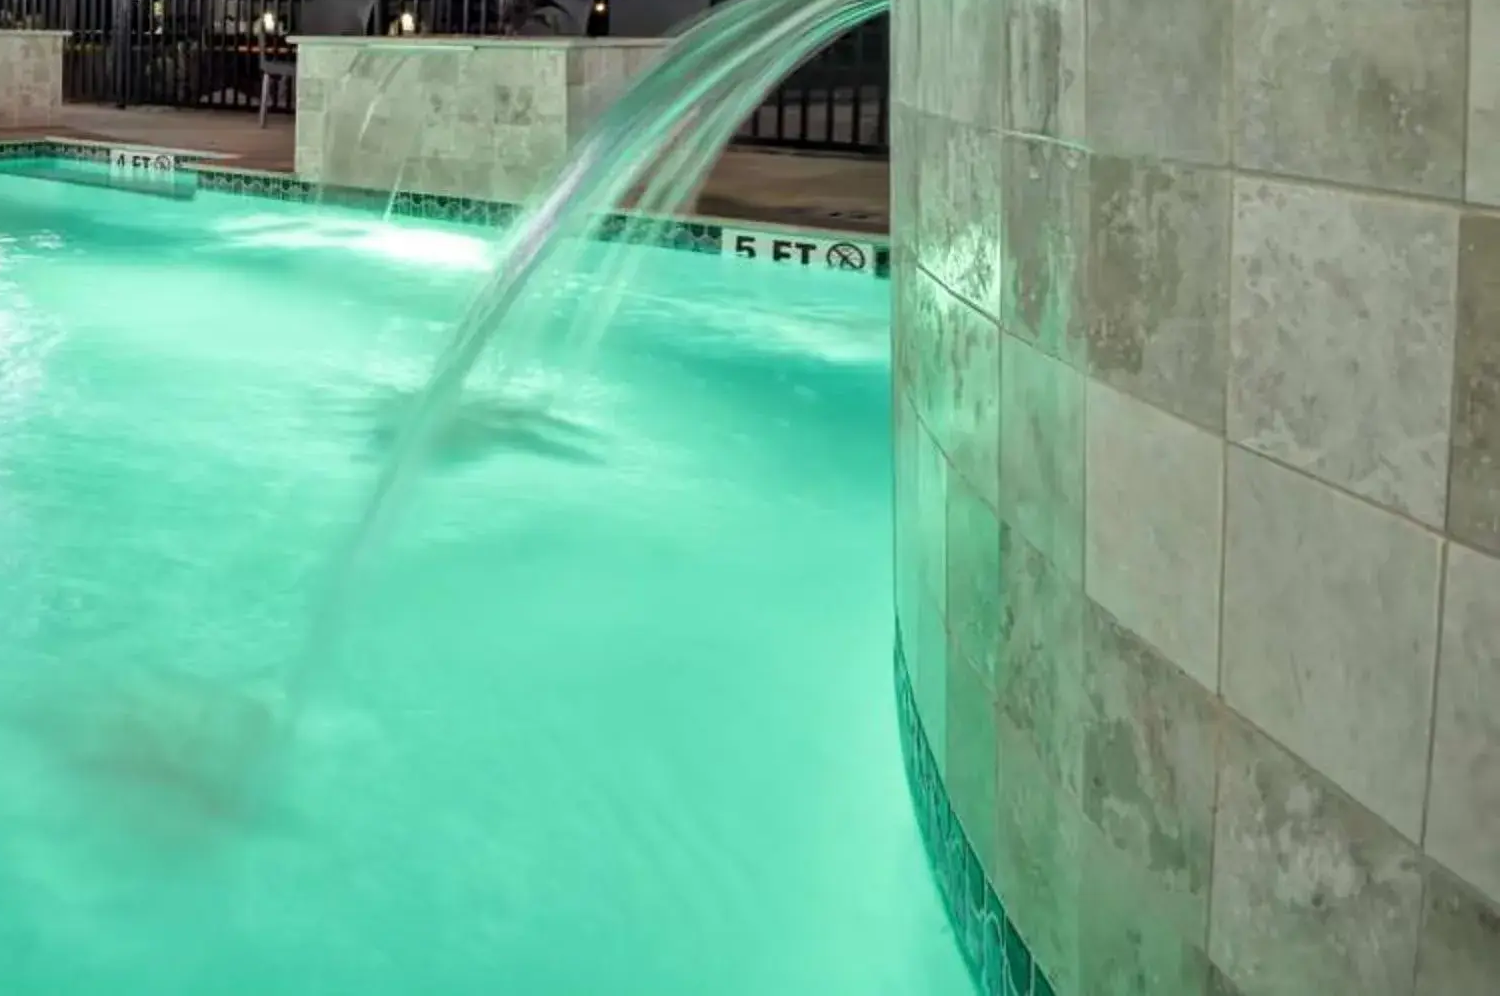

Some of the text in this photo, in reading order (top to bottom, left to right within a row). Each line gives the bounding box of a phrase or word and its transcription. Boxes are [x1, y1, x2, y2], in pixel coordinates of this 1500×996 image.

[131, 155, 151, 169] FT
[735, 235, 817, 265] 5 FT
